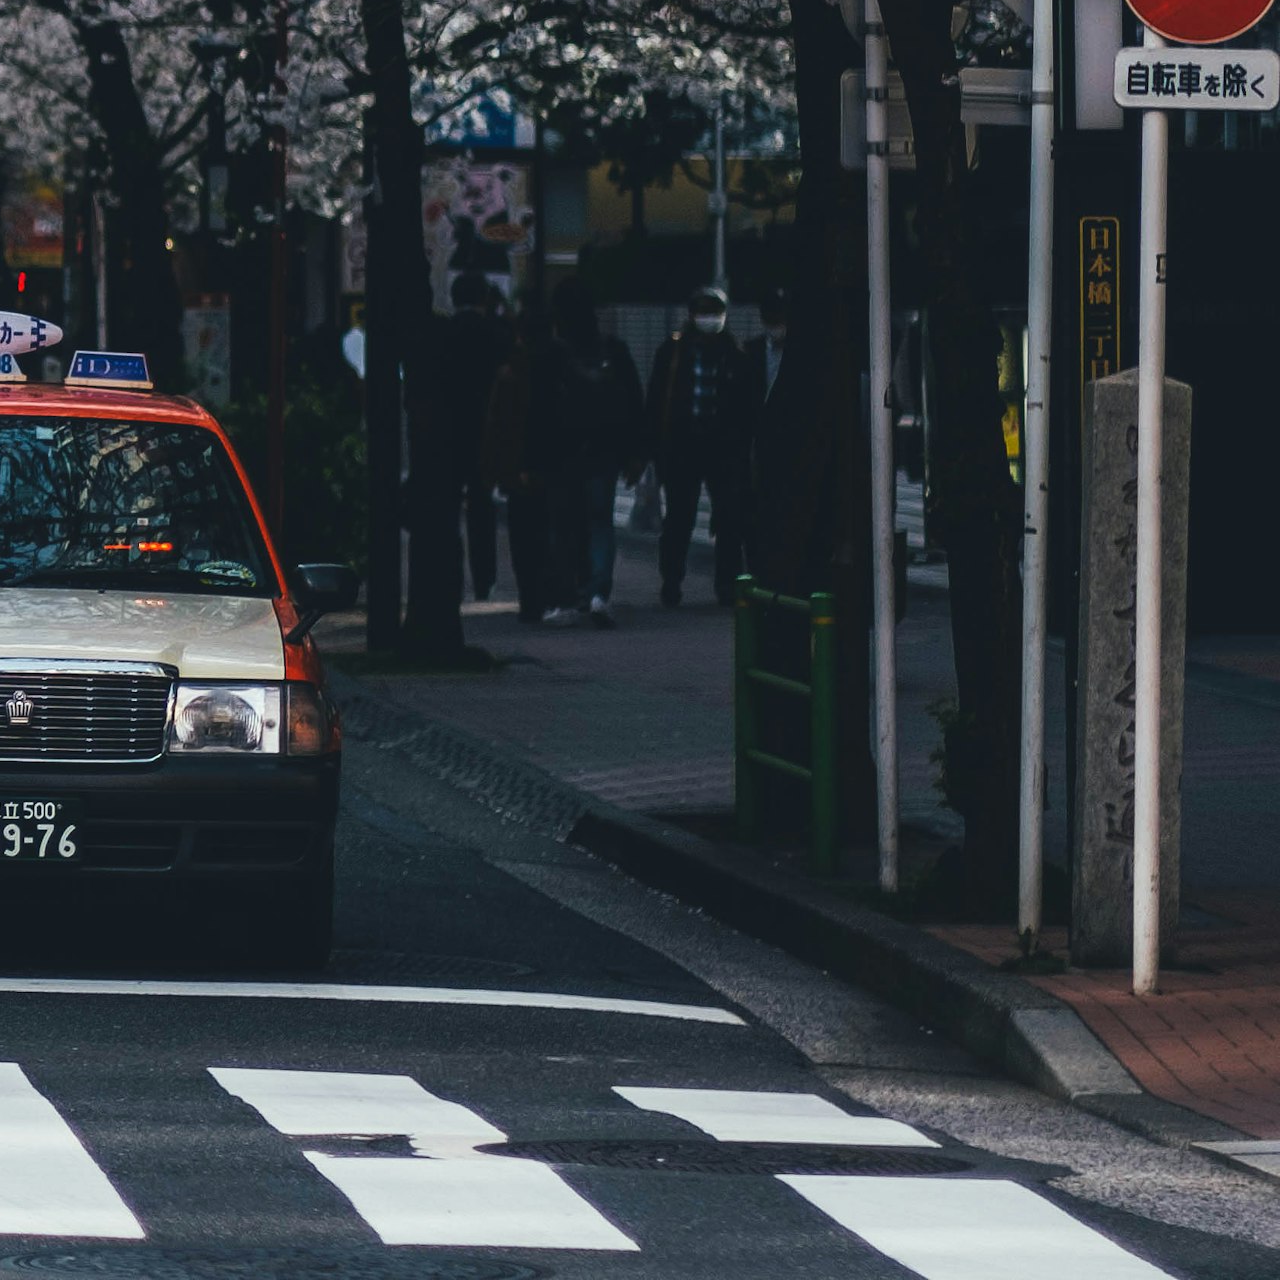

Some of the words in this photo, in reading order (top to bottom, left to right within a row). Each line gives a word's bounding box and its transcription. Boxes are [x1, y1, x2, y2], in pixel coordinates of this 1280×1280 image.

[1127, 61, 1265, 99] 自転車を除く
